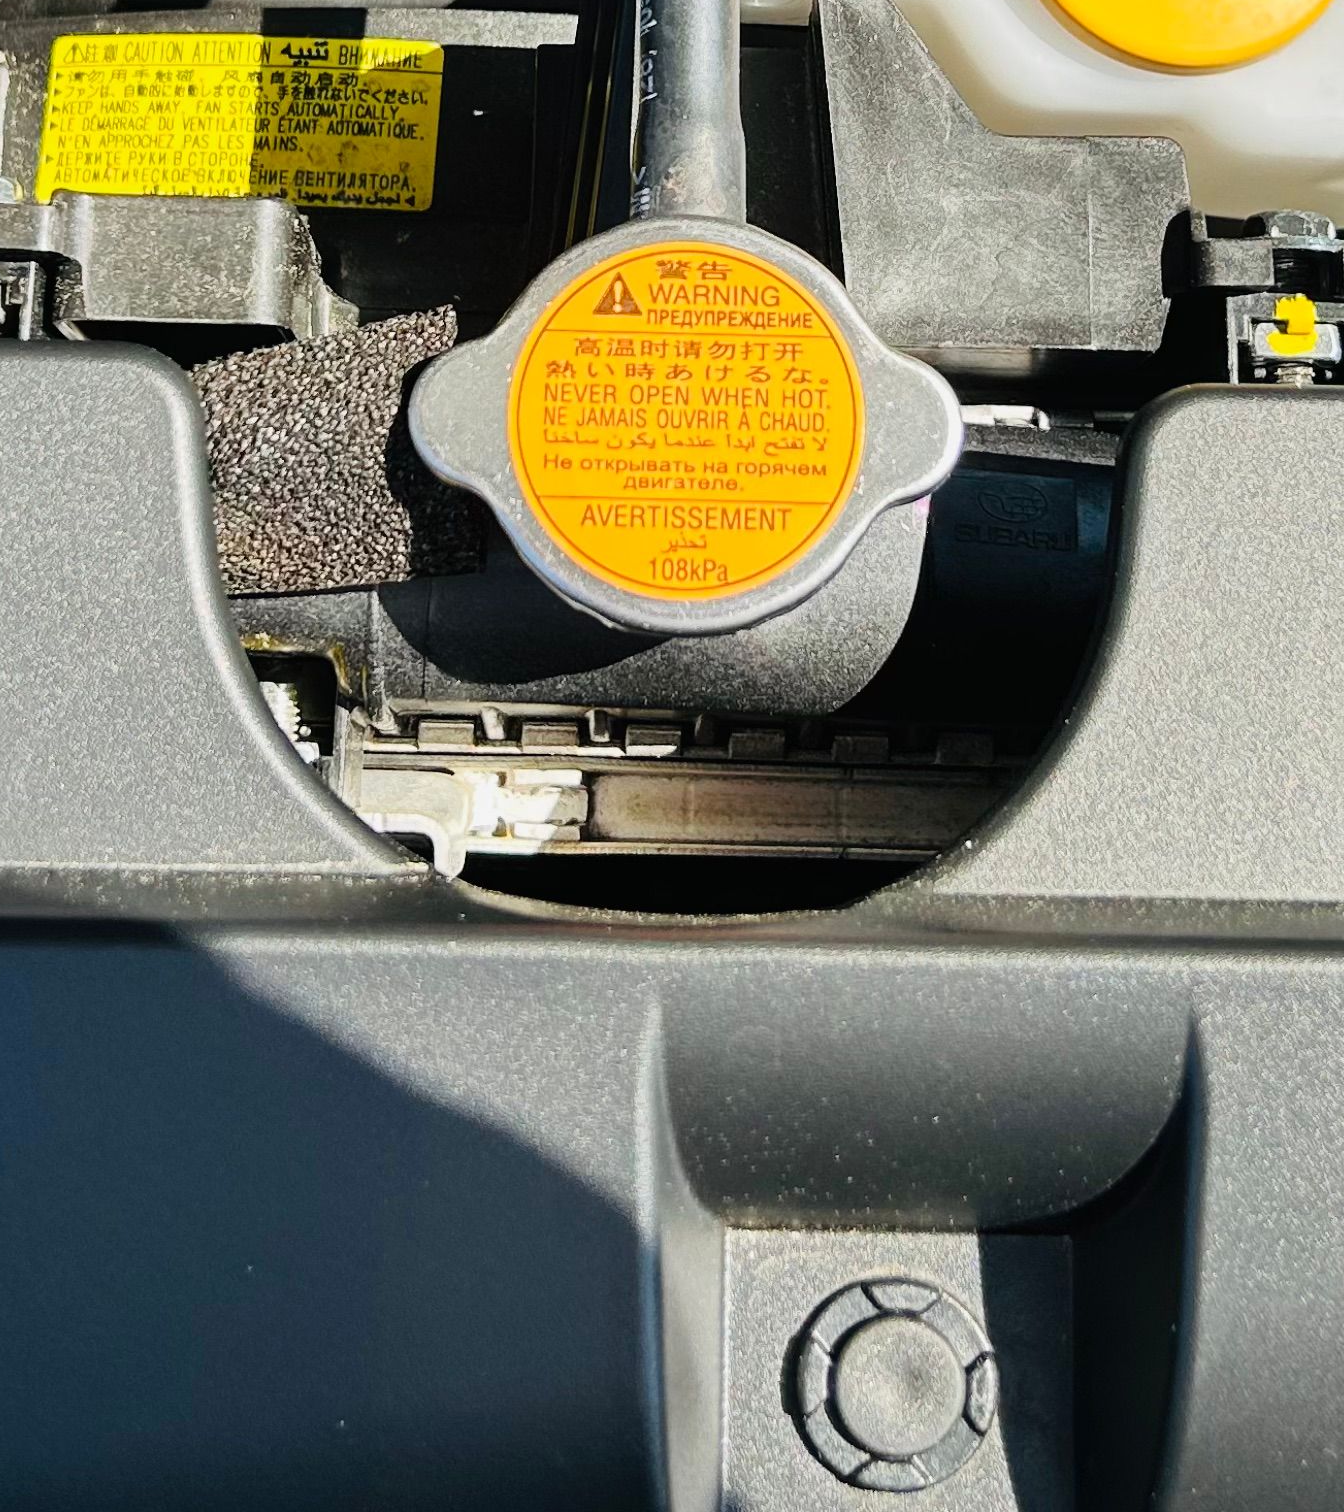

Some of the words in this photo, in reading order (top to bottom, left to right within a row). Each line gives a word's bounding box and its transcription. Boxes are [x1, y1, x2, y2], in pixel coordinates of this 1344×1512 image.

[125, 41, 184, 63] CAUTION
[192, 41, 271, 64] ATTENTION
[281, 41, 329, 67] تنبيه
[62, 102, 93, 114] KEEP
[100, 101, 139, 114] HANDS
[196, 101, 221, 114] FAN
[230, 101, 279, 115] STARTS
[60, 118, 74, 132] LE
[82, 115, 150, 133] DÉMARRAGE
[159, 117, 175, 131] DU
[183, 117, 271, 133] VENTILATEUR
[278, 116, 319, 134] ÉTANT
[99, 133, 175, 149] APPROCHEZ
[184, 134, 209, 149] PAS
[218, 134, 245, 149] LES
[253, 136, 303, 152] MAINS.
[56, 151, 121, 167] ДЕРЖИТЕ
[128, 151, 167, 166] РУКИ
[174, 152, 182, 165] В
[188, 152, 264, 169] СТОРОНЕ.
[54, 168, 191, 184] АВТОМАТИЧЕСКОЕ
[195, 168, 289, 185] ВКЛЮЧЕНИЕ
[295, 170, 416, 193] ВЕНТИЛЯТОРА.
[657, 260, 732, 281] 警告
[648, 283, 780, 307] WARNING
[646, 309, 813, 330] ПРЕДУПРЕЖДЕНИЕ
[574, 337, 804, 362] 高温时请勿打开
[544, 383, 616, 404] NEVER
[630, 384, 689, 406] OPEN
[701, 387, 768, 408] WHEN
[782, 388, 831, 409] HOT.
[544, 406, 566, 425] NE
[576, 407, 647, 428] JAMAIS
[657, 408, 728, 430] OUVRIR
[760, 411, 831, 432] CHAUD.
[606, 432, 656, 449] يكون
[664, 433, 716, 448] عندما
[763, 437, 806, 457] تفتح
[812, 436, 827, 451] لا
[544, 454, 573, 470] Не
[580, 458, 696, 474] открывать
[704, 462, 728, 474] на
[736, 462, 827, 477] горячем
[623, 476, 744, 492] двигателе.
[580, 504, 792, 531] AVERTISSEMENT
[661, 532, 707, 554] تحذير
[955, 523, 1073, 552] SUBARU
[649, 557, 728, 582] 108kPa
